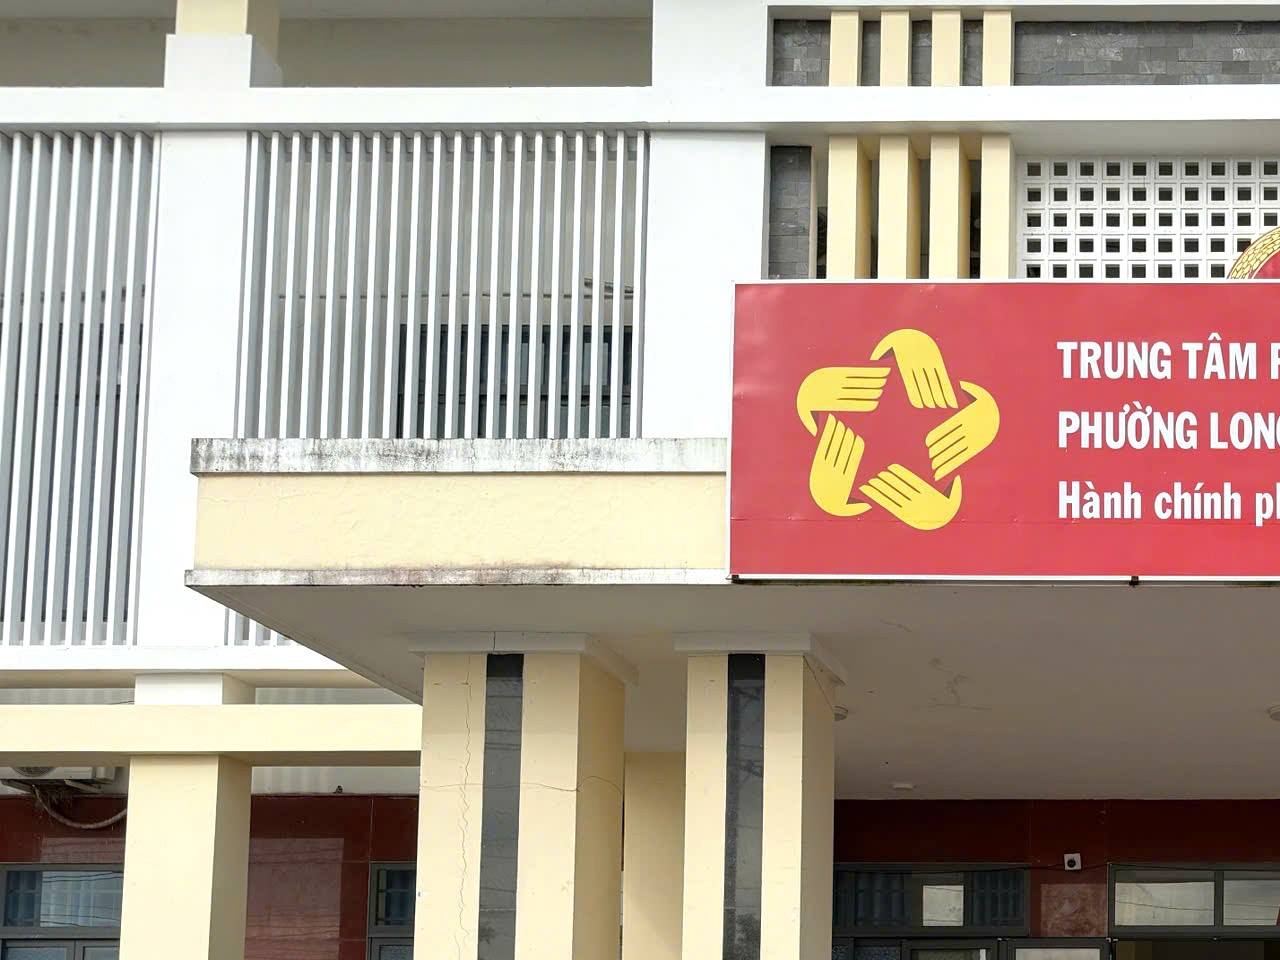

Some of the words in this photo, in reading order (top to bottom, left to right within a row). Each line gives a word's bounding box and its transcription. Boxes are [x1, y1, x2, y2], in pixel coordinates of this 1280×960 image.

[1056, 340, 1172, 380] TRUNG
[1181, 332, 1257, 380] TÂM
[1058, 400, 1198, 452] PHƯỜNG
[1058, 480, 1142, 520] Hành
[1154, 481, 1242, 520] chính
